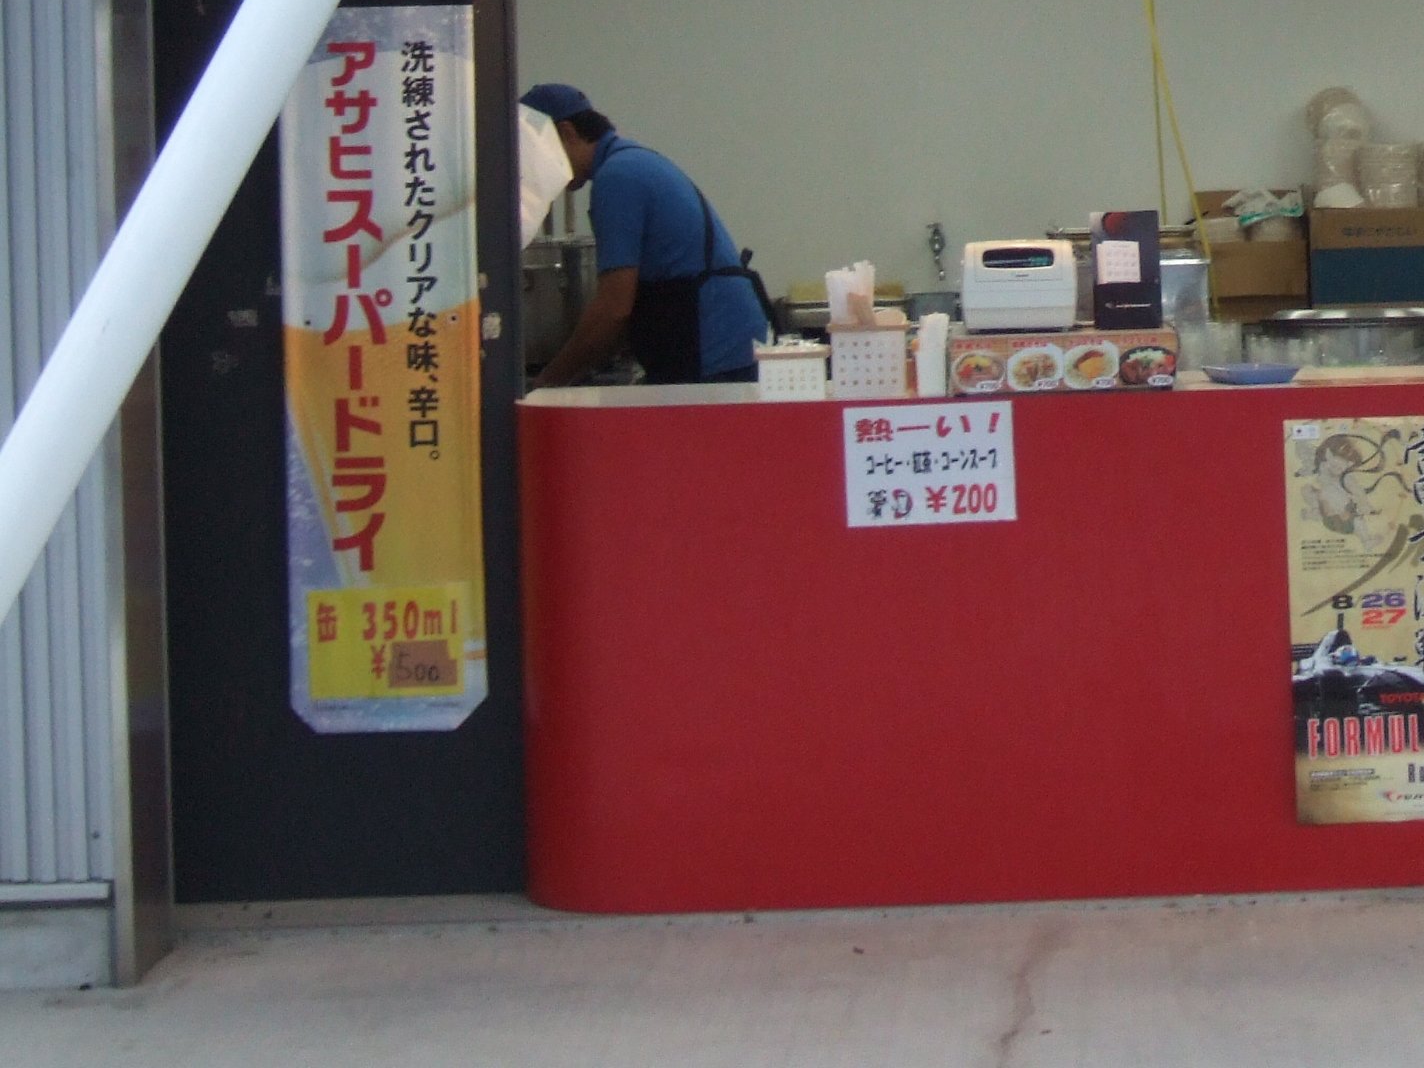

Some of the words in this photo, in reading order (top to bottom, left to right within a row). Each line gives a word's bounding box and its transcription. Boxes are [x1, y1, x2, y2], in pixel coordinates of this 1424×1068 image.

[322, 41, 393, 572] アサヒスーパードライ
[401, 40, 441, 461] 洗練されたクリアな味、辛口。
[925, 482, 998, 515] ¥200
[1361, 608, 1407, 625] 27
